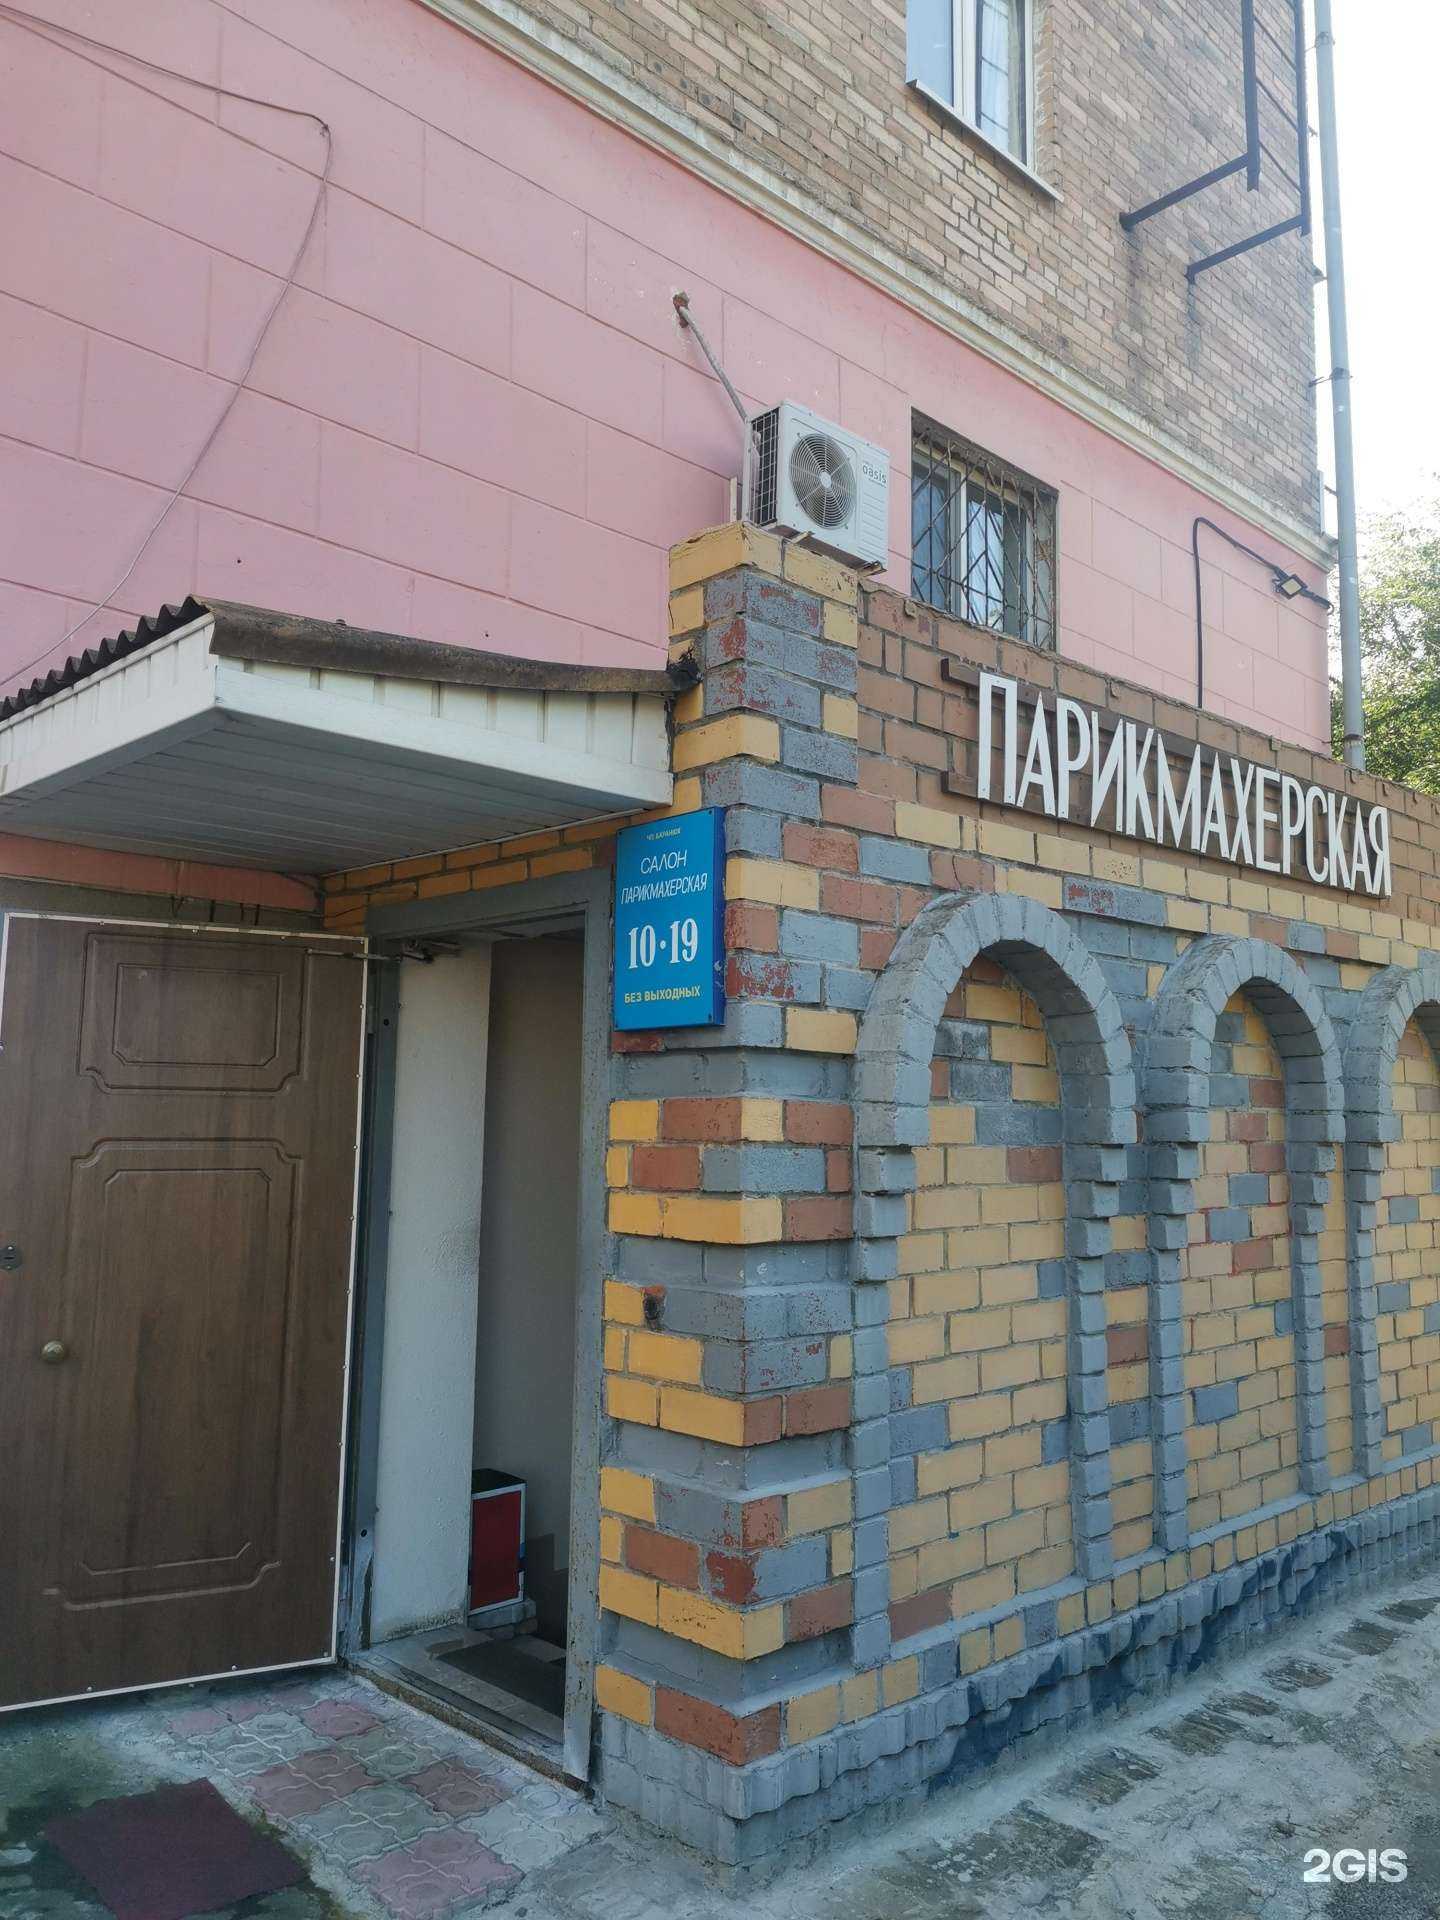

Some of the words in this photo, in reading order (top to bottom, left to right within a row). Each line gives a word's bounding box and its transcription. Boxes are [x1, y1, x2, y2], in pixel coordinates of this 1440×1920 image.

[862, 465, 887, 484] oasis
[977, 671, 1393, 897] ПАРИКМАХЕРСКАЯ
[640, 849, 688, 874] САЛОН
[620, 872, 708, 905] ПАРИКМАХЕРСКАЯ
[624, 991, 642, 1004] БЕЗ
[644, 984, 701, 1002] ВЫХОДНЫХ
